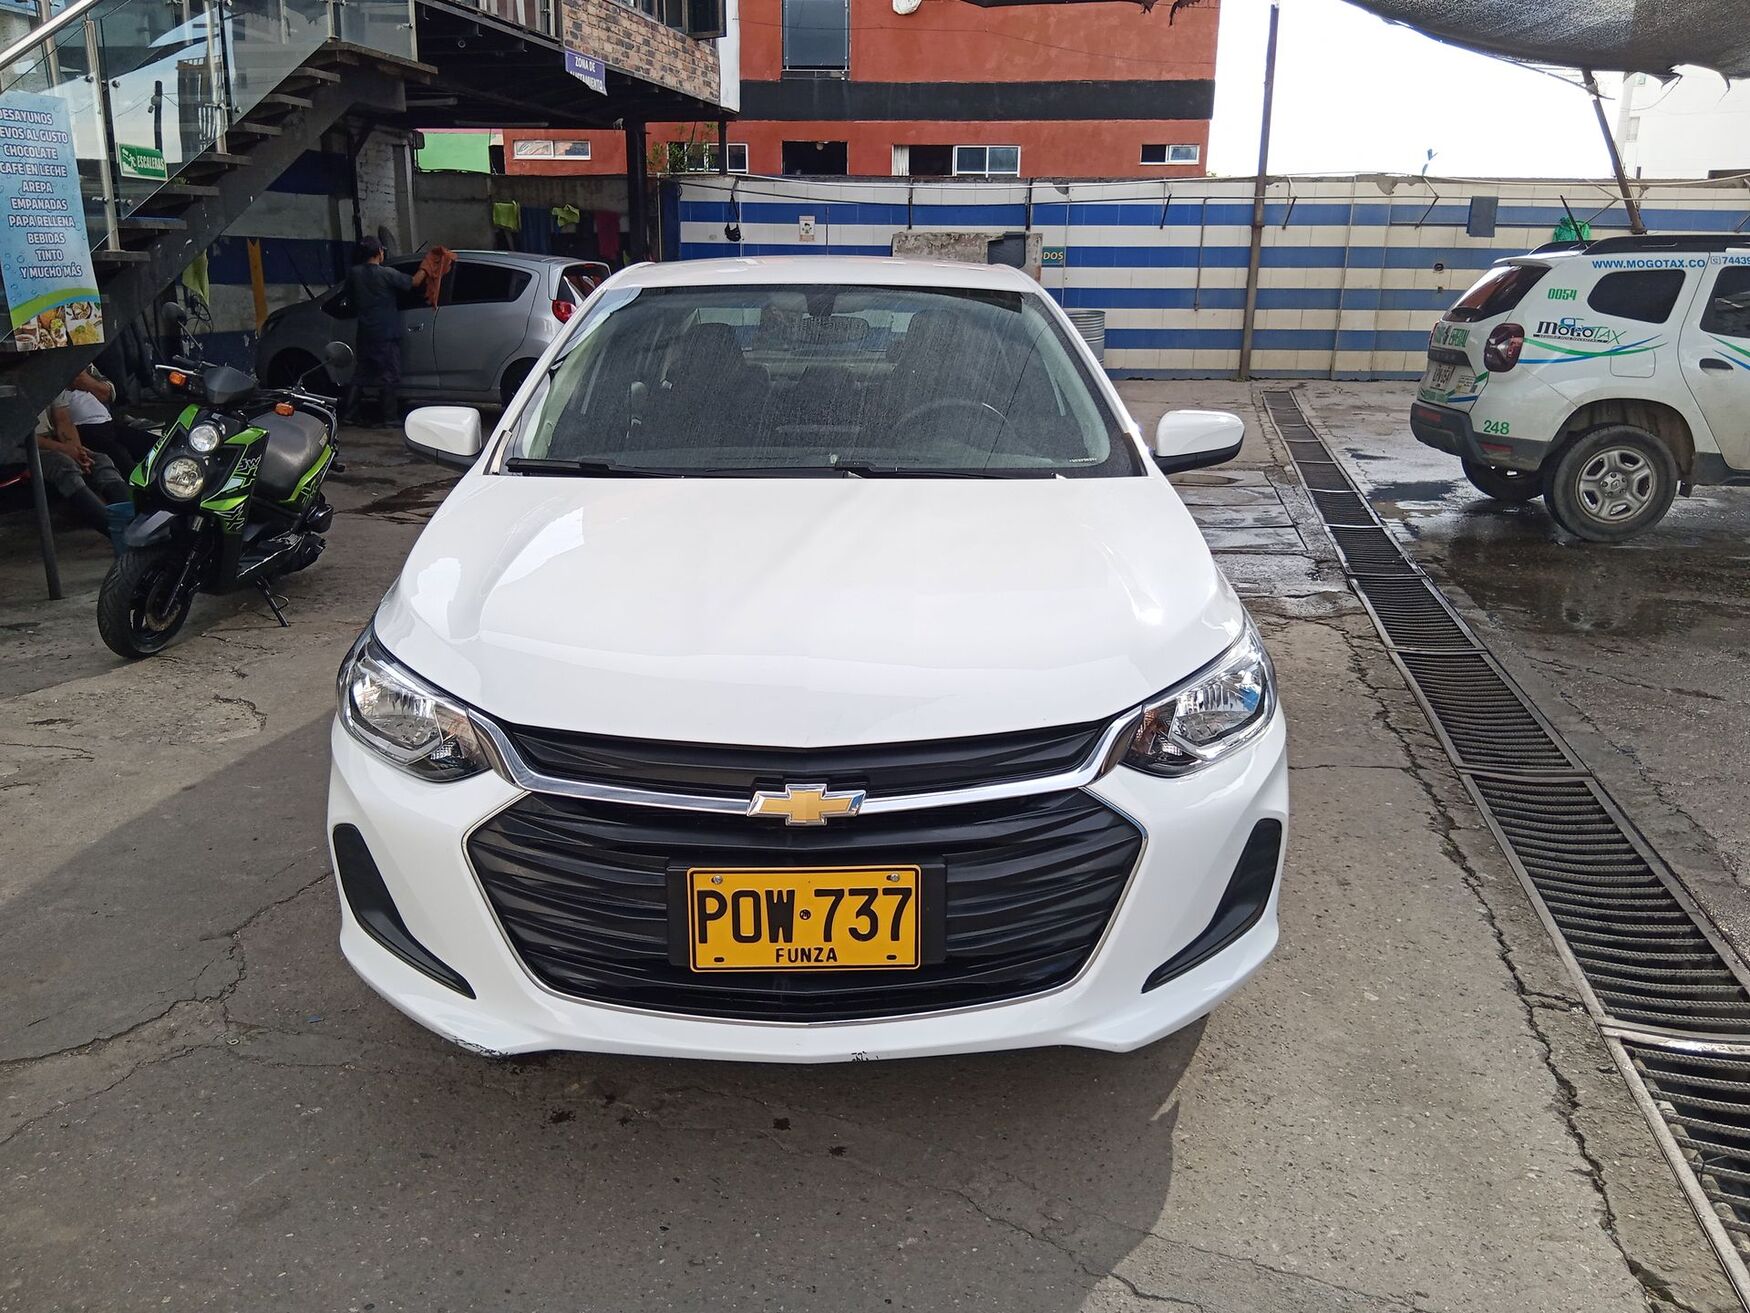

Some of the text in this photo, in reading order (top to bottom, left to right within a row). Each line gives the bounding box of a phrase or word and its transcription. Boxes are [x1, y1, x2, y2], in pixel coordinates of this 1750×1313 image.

[575, 56, 596, 72] ZONA DE
[26, 129, 39, 141] AL
[40, 130, 68, 143] GUSTO
[4, 145, 58, 159] CHOCOLATE
[0, 162, 67, 177] CAFE EN LECHE
[137, 155, 165, 171] ESCALERAS
[22, 181, 53, 193] AREPA
[11, 198, 68, 210] EMPANADAS
[9, 215, 75, 227] PAPA RELLENA
[27, 233, 65, 244] BEBIDAS
[36, 250, 63, 261] TINTO
[21, 262, 82, 278] Y MUCHO MÁS
[1592, 258, 1706, 269] WWW.MOGOTAX.CO
[1547, 288, 1577, 301] 0054
[1483, 419, 1510, 435] 248
[696, 887, 913, 944] POW 737
[775, 947, 838, 963] FUNZA
